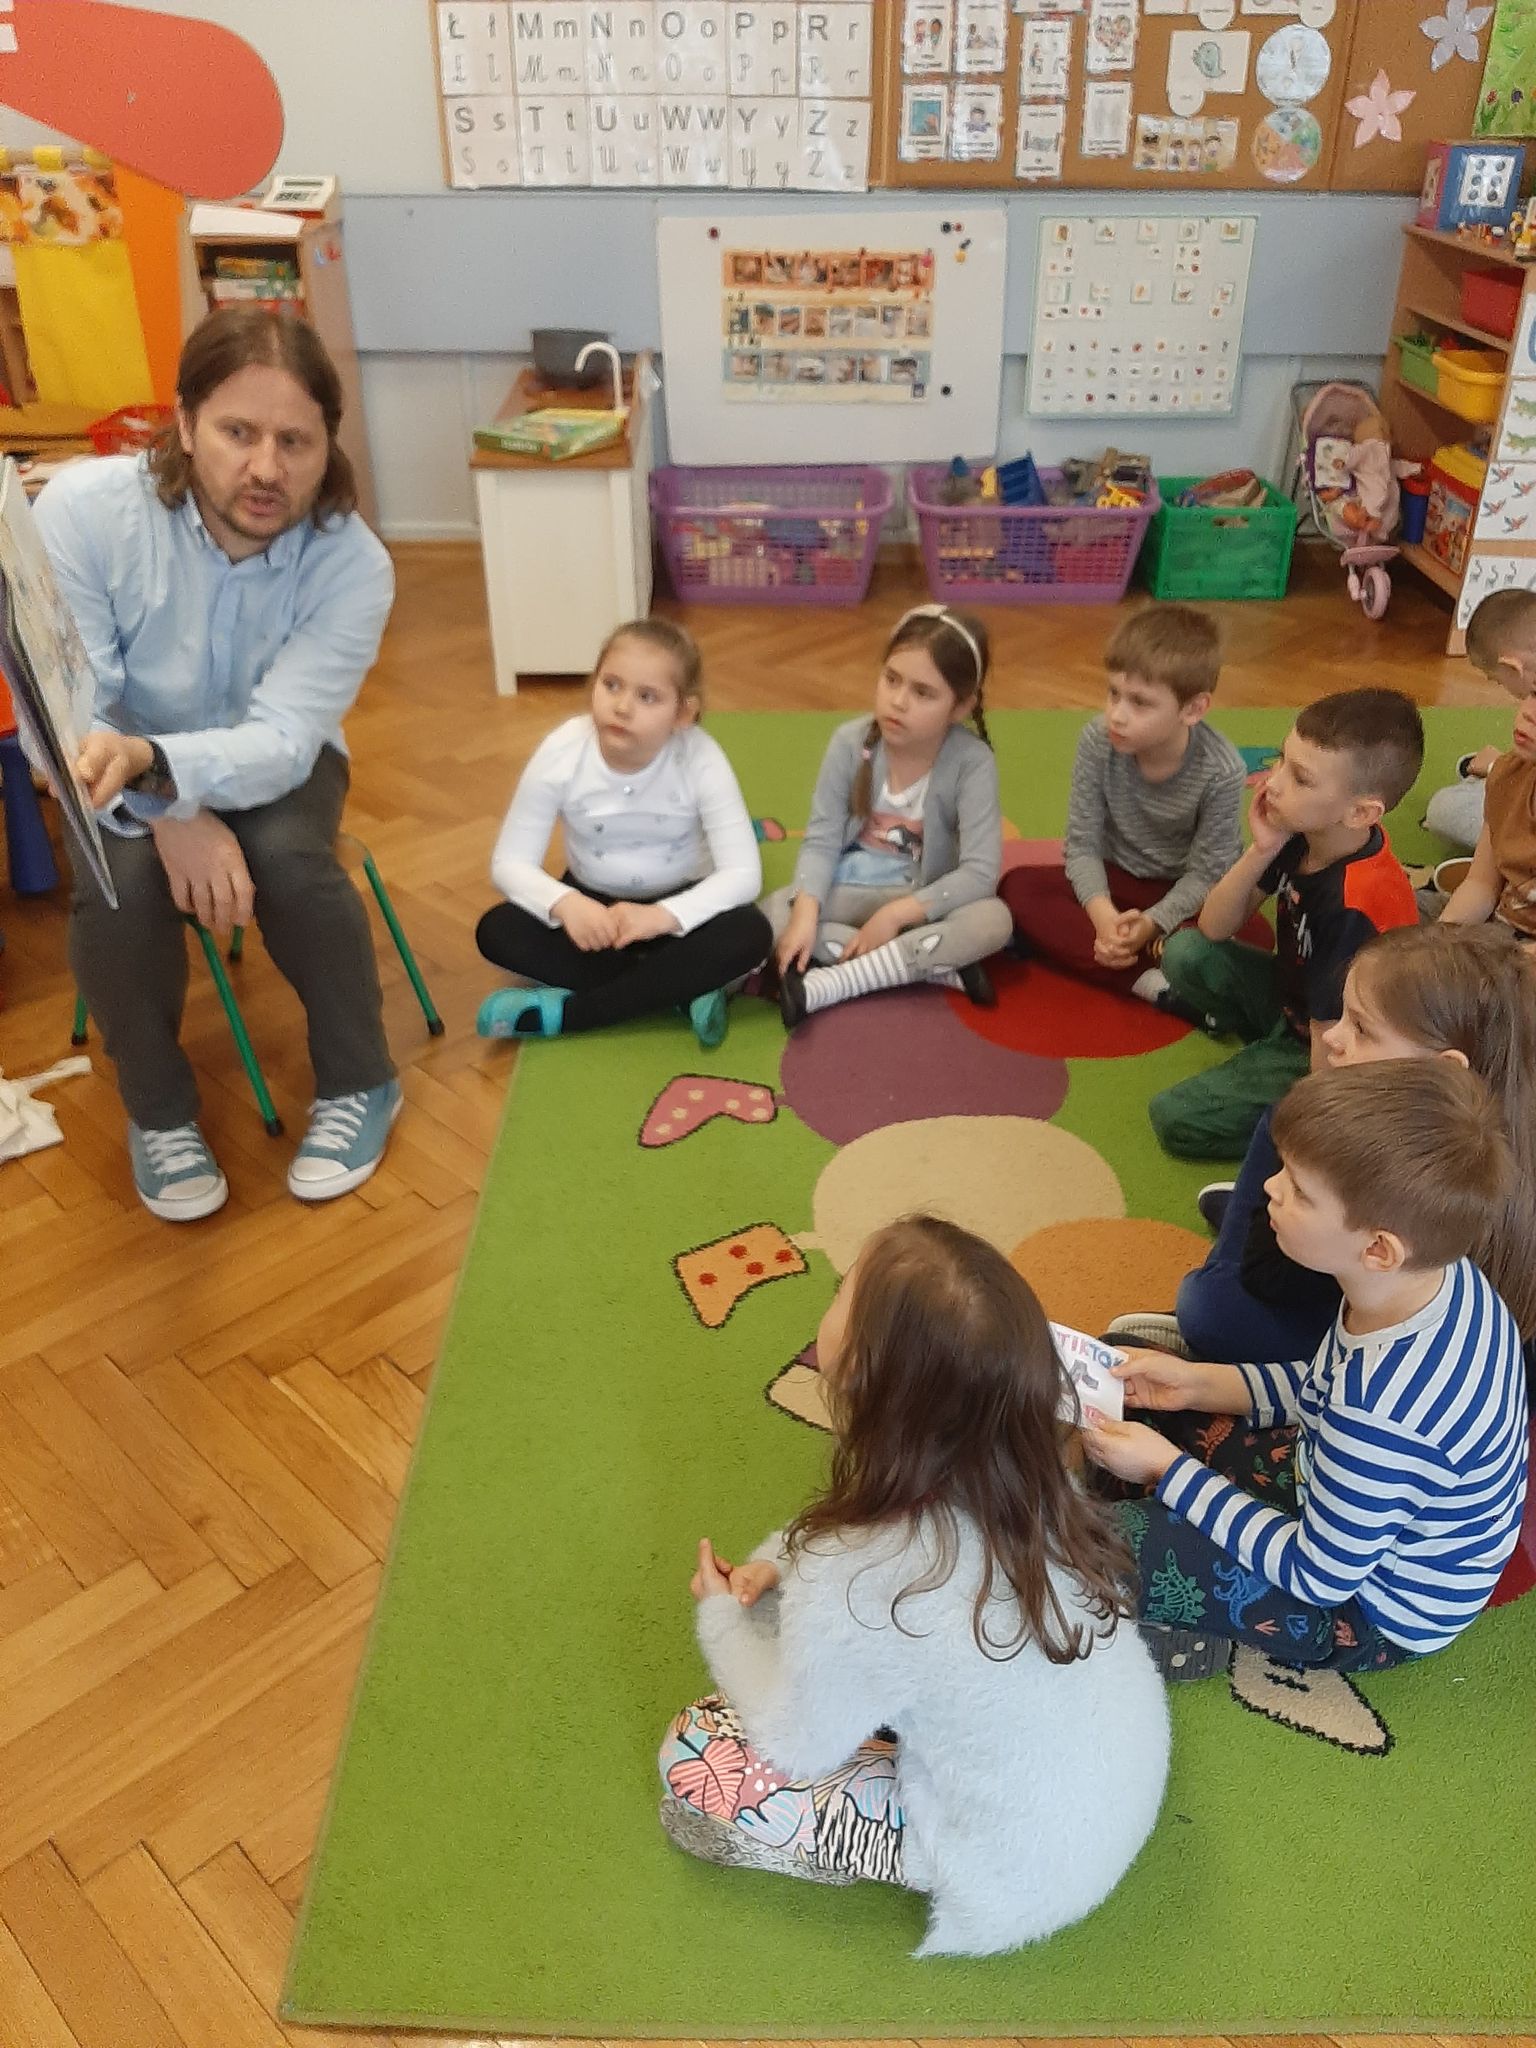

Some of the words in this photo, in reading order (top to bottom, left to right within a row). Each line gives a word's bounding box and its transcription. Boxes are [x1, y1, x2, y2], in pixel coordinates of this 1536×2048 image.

[517, 12, 544, 39] M
[553, 18, 578, 39] m
[591, 12, 613, 39] N
[630, 19, 646, 38] n
[735, 12, 755, 39] P
[773, 20, 788, 44] p
[808, 14, 828, 41] R
[454, 106, 475, 133] S
[526, 106, 544, 132] T
[596, 106, 617, 131] U
[808, 109, 829, 135] Z
